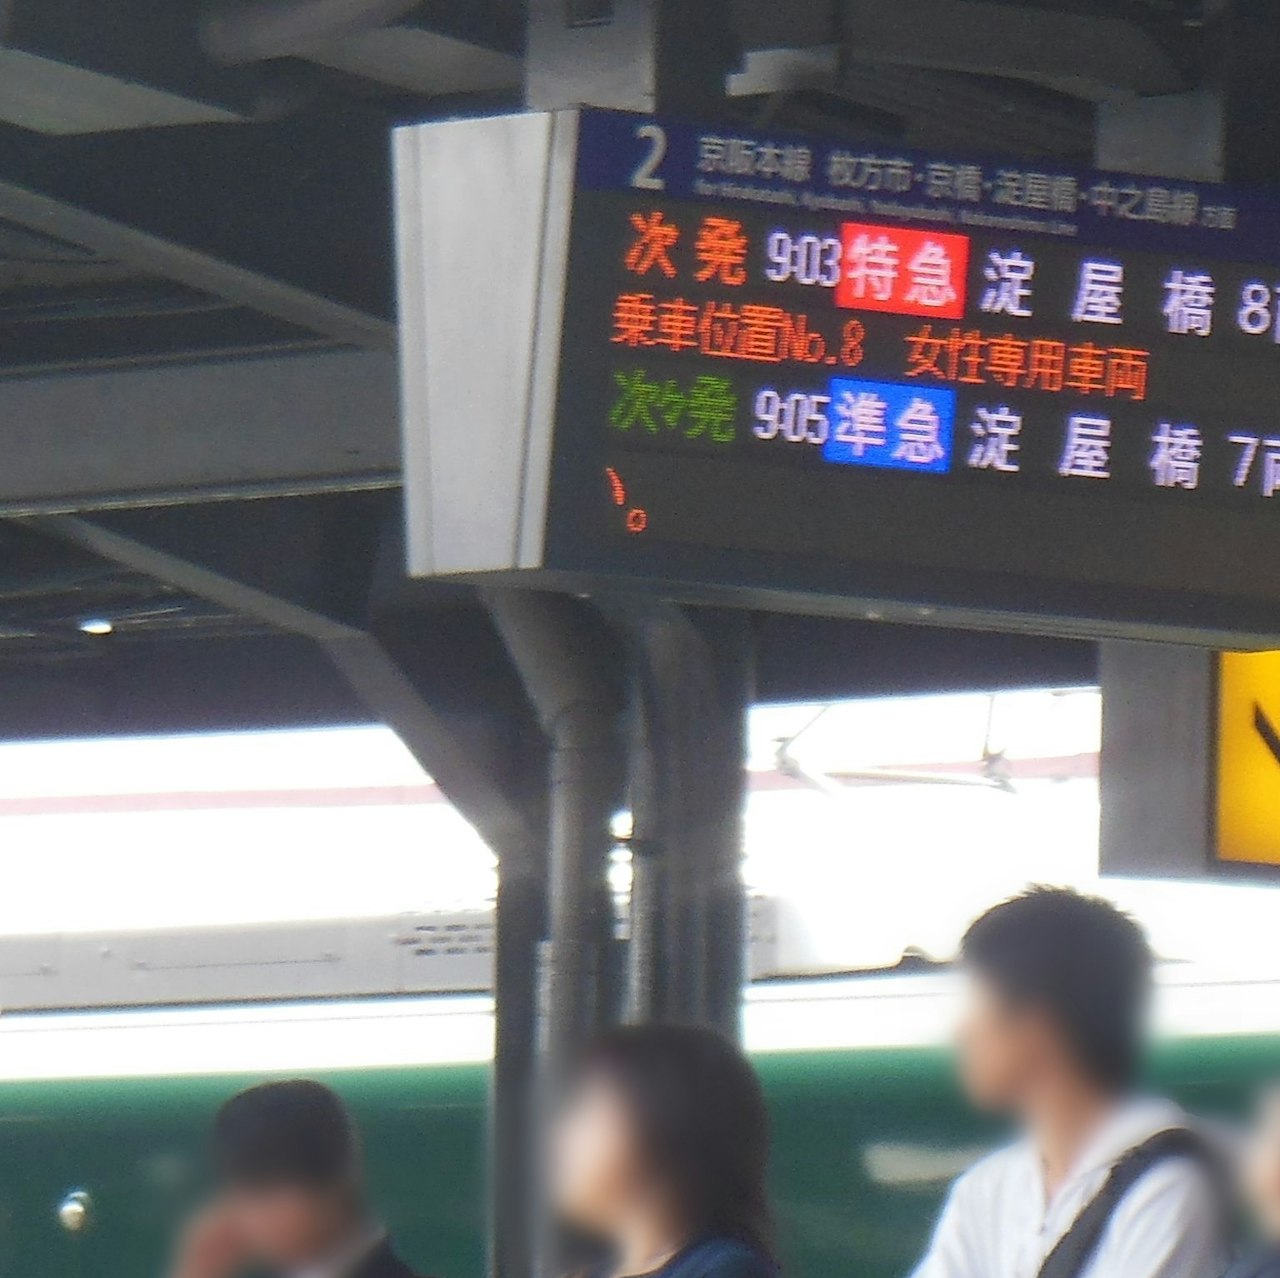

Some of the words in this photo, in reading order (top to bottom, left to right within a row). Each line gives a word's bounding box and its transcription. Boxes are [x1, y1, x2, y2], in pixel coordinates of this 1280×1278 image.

[631, 125, 667, 190] 2
[624, 210, 750, 287] 次発
[846, 232, 957, 308] 特急
[979, 249, 1217, 339] 淀屋橋
[832, 390, 946, 465] 準急
[967, 404, 1205, 491] 淀屋橋
